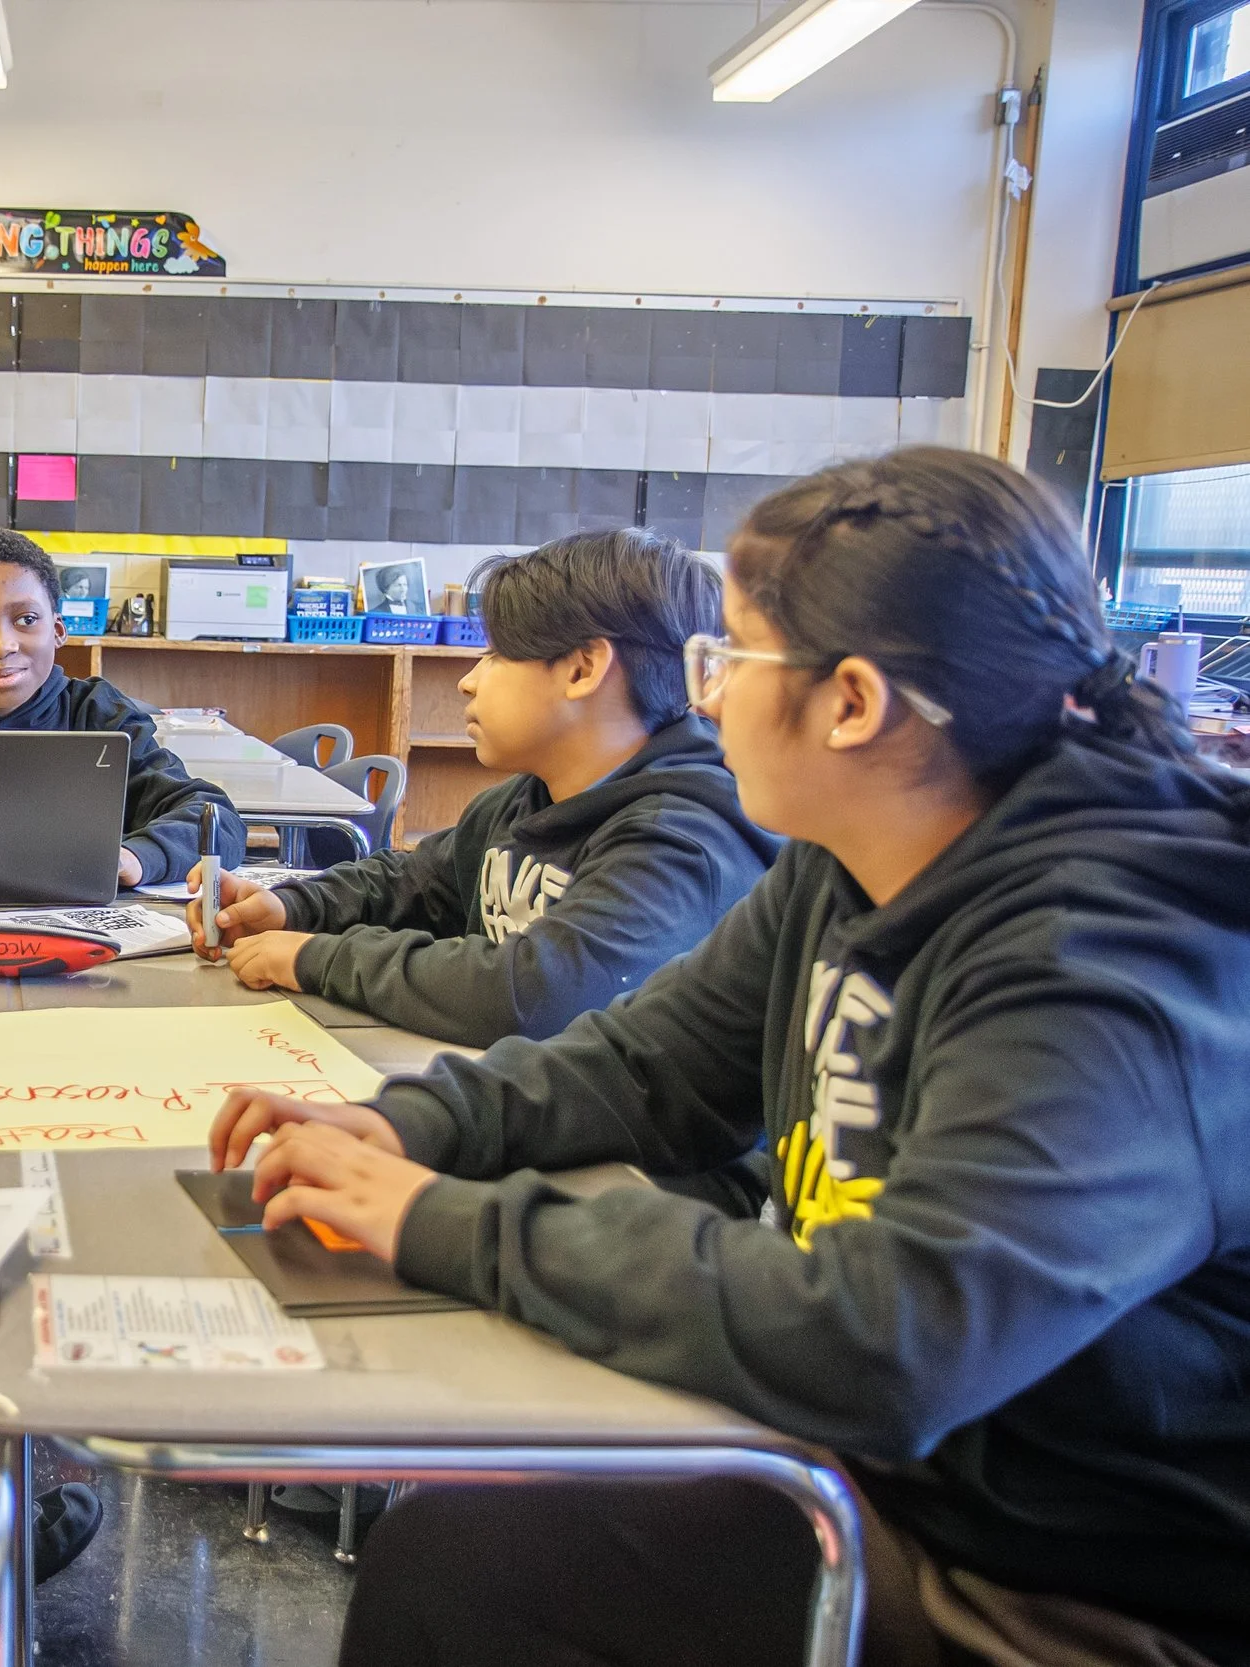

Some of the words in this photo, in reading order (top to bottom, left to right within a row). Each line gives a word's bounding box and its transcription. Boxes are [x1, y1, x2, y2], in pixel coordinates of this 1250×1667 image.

[57, 226, 170, 259] THINGS
[84, 257, 129, 275] happen
[131, 259, 159, 272] here
